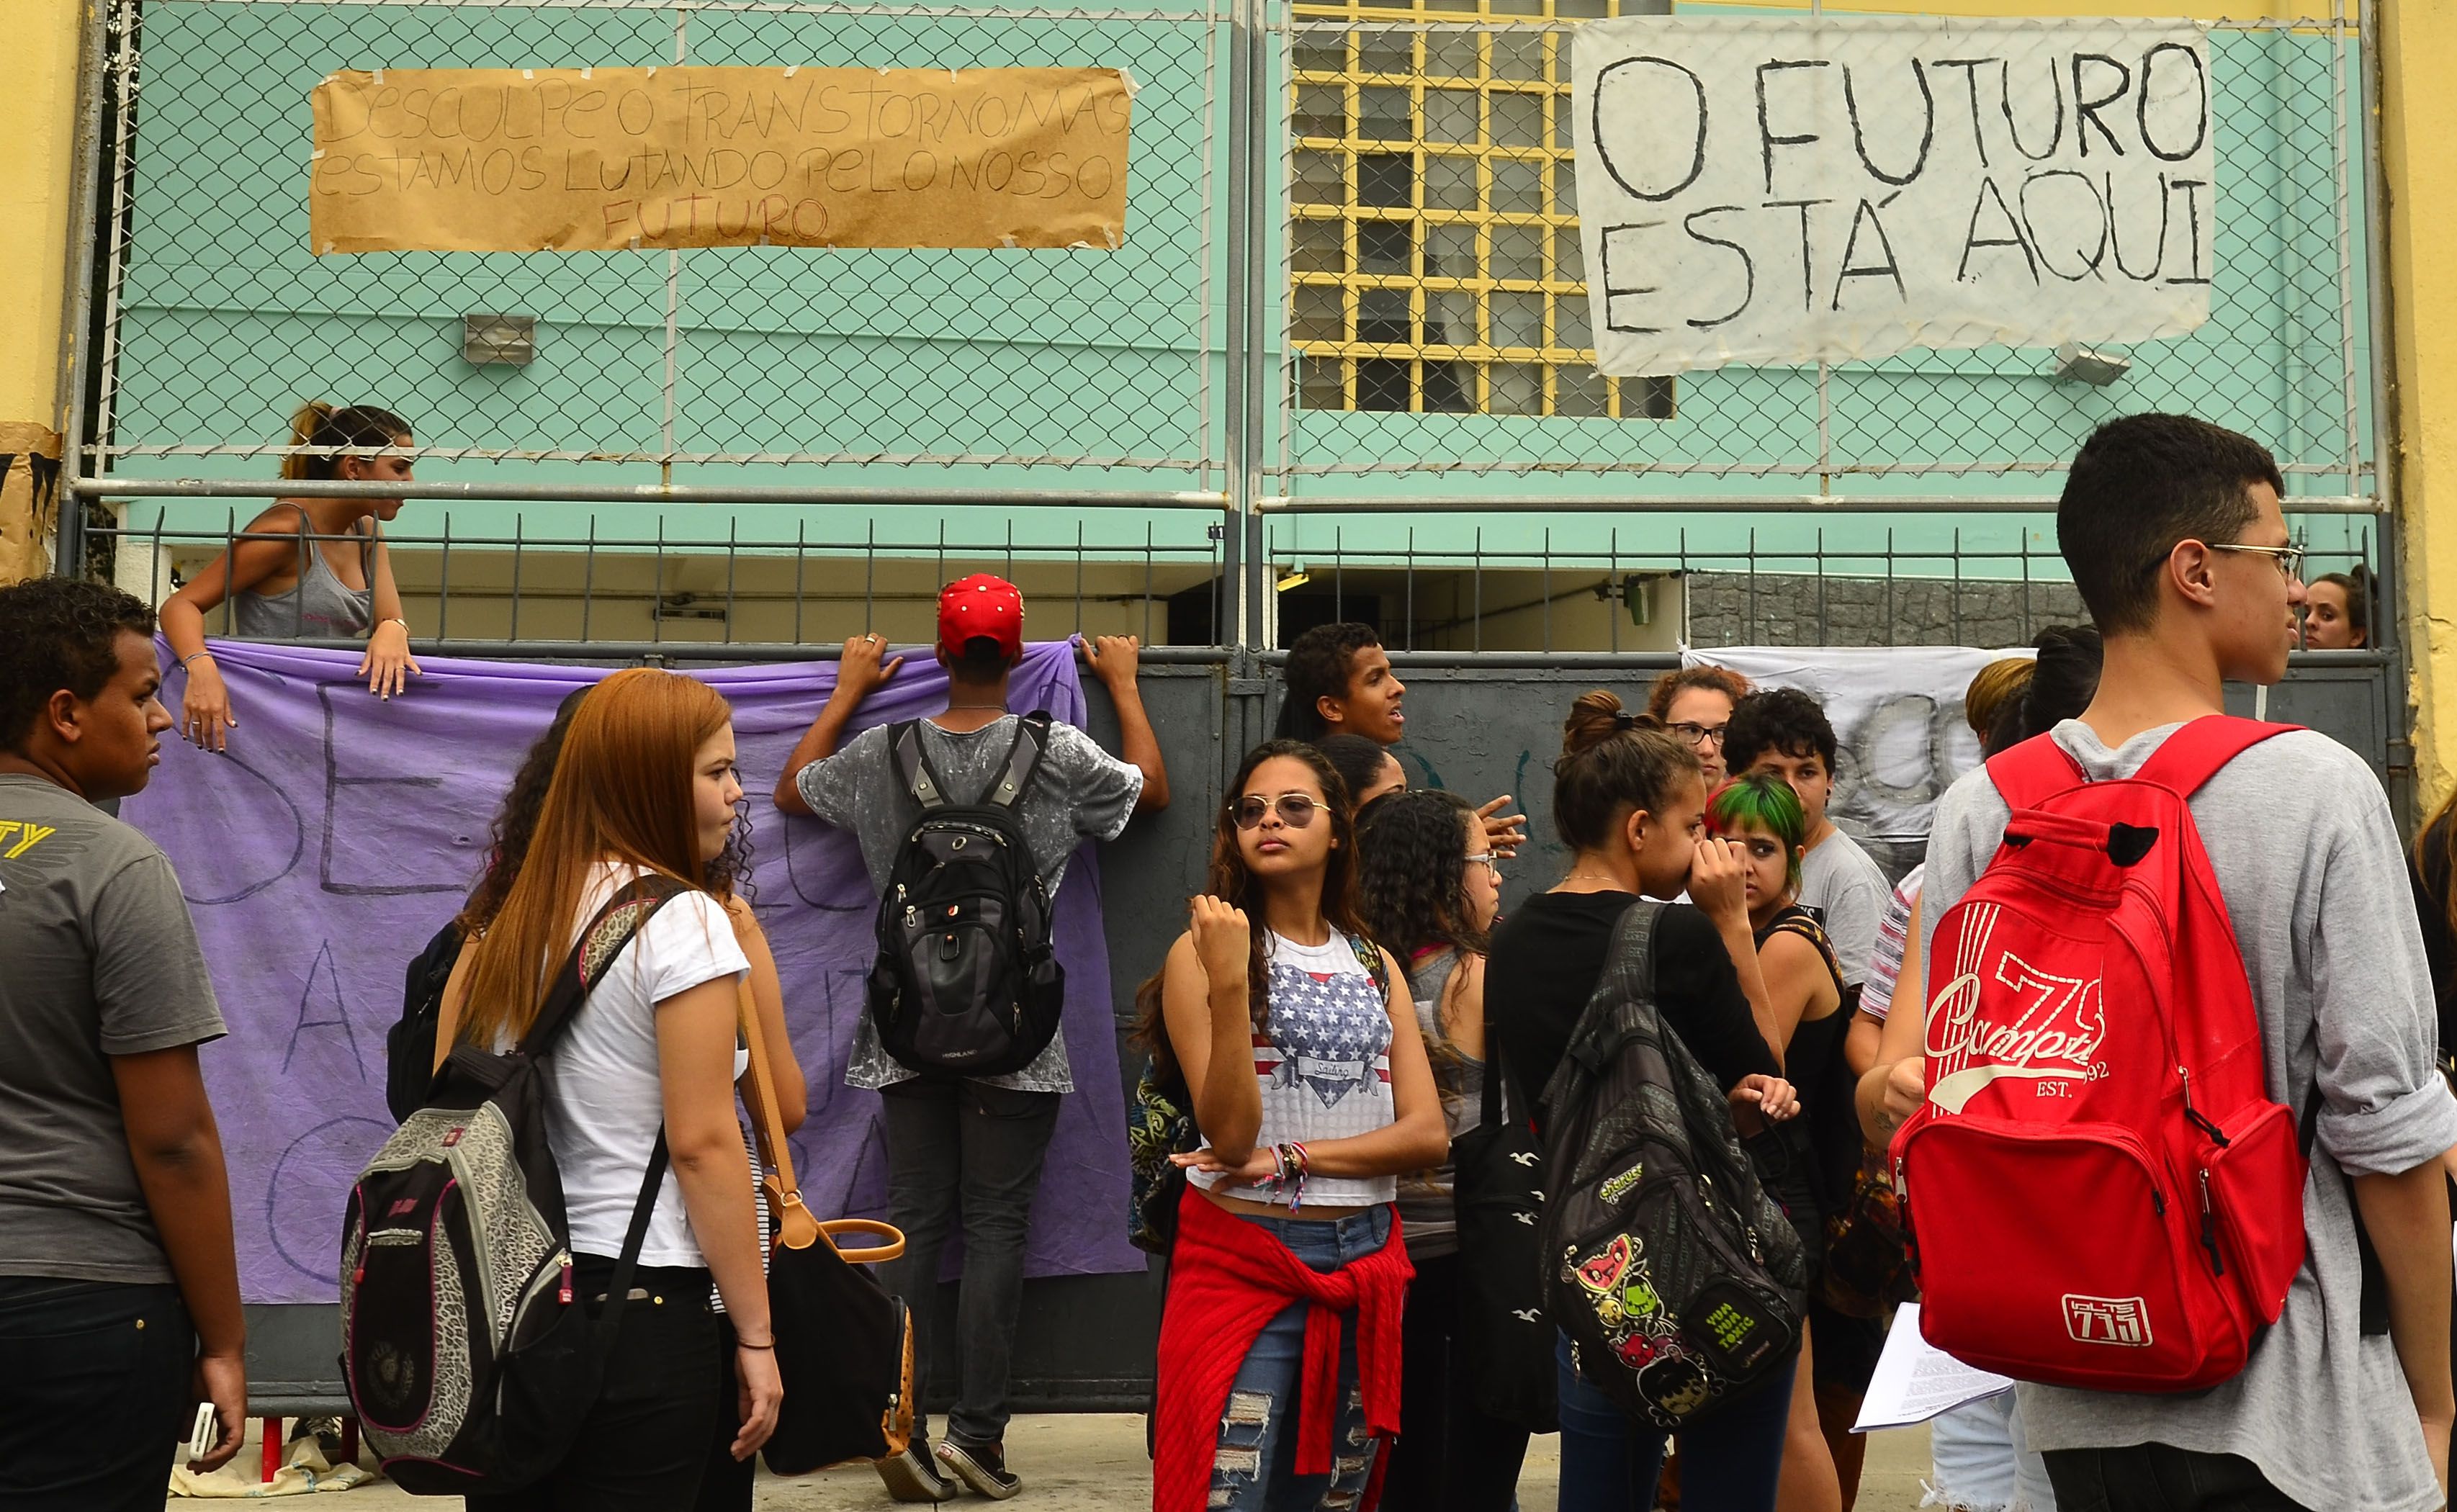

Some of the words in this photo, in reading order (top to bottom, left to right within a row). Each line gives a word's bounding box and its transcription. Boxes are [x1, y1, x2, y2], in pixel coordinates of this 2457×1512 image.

[1593, 56, 1707, 202] O
[1756, 41, 2206, 194] FUTURO
[565, 143, 786, 192] LUTANDO
[951, 148, 1112, 200] NOSSO
[602, 192, 828, 241] FUTURO
[1600, 191, 1907, 334] ESTÁ
[2036, 1081, 2073, 1099] EST.
